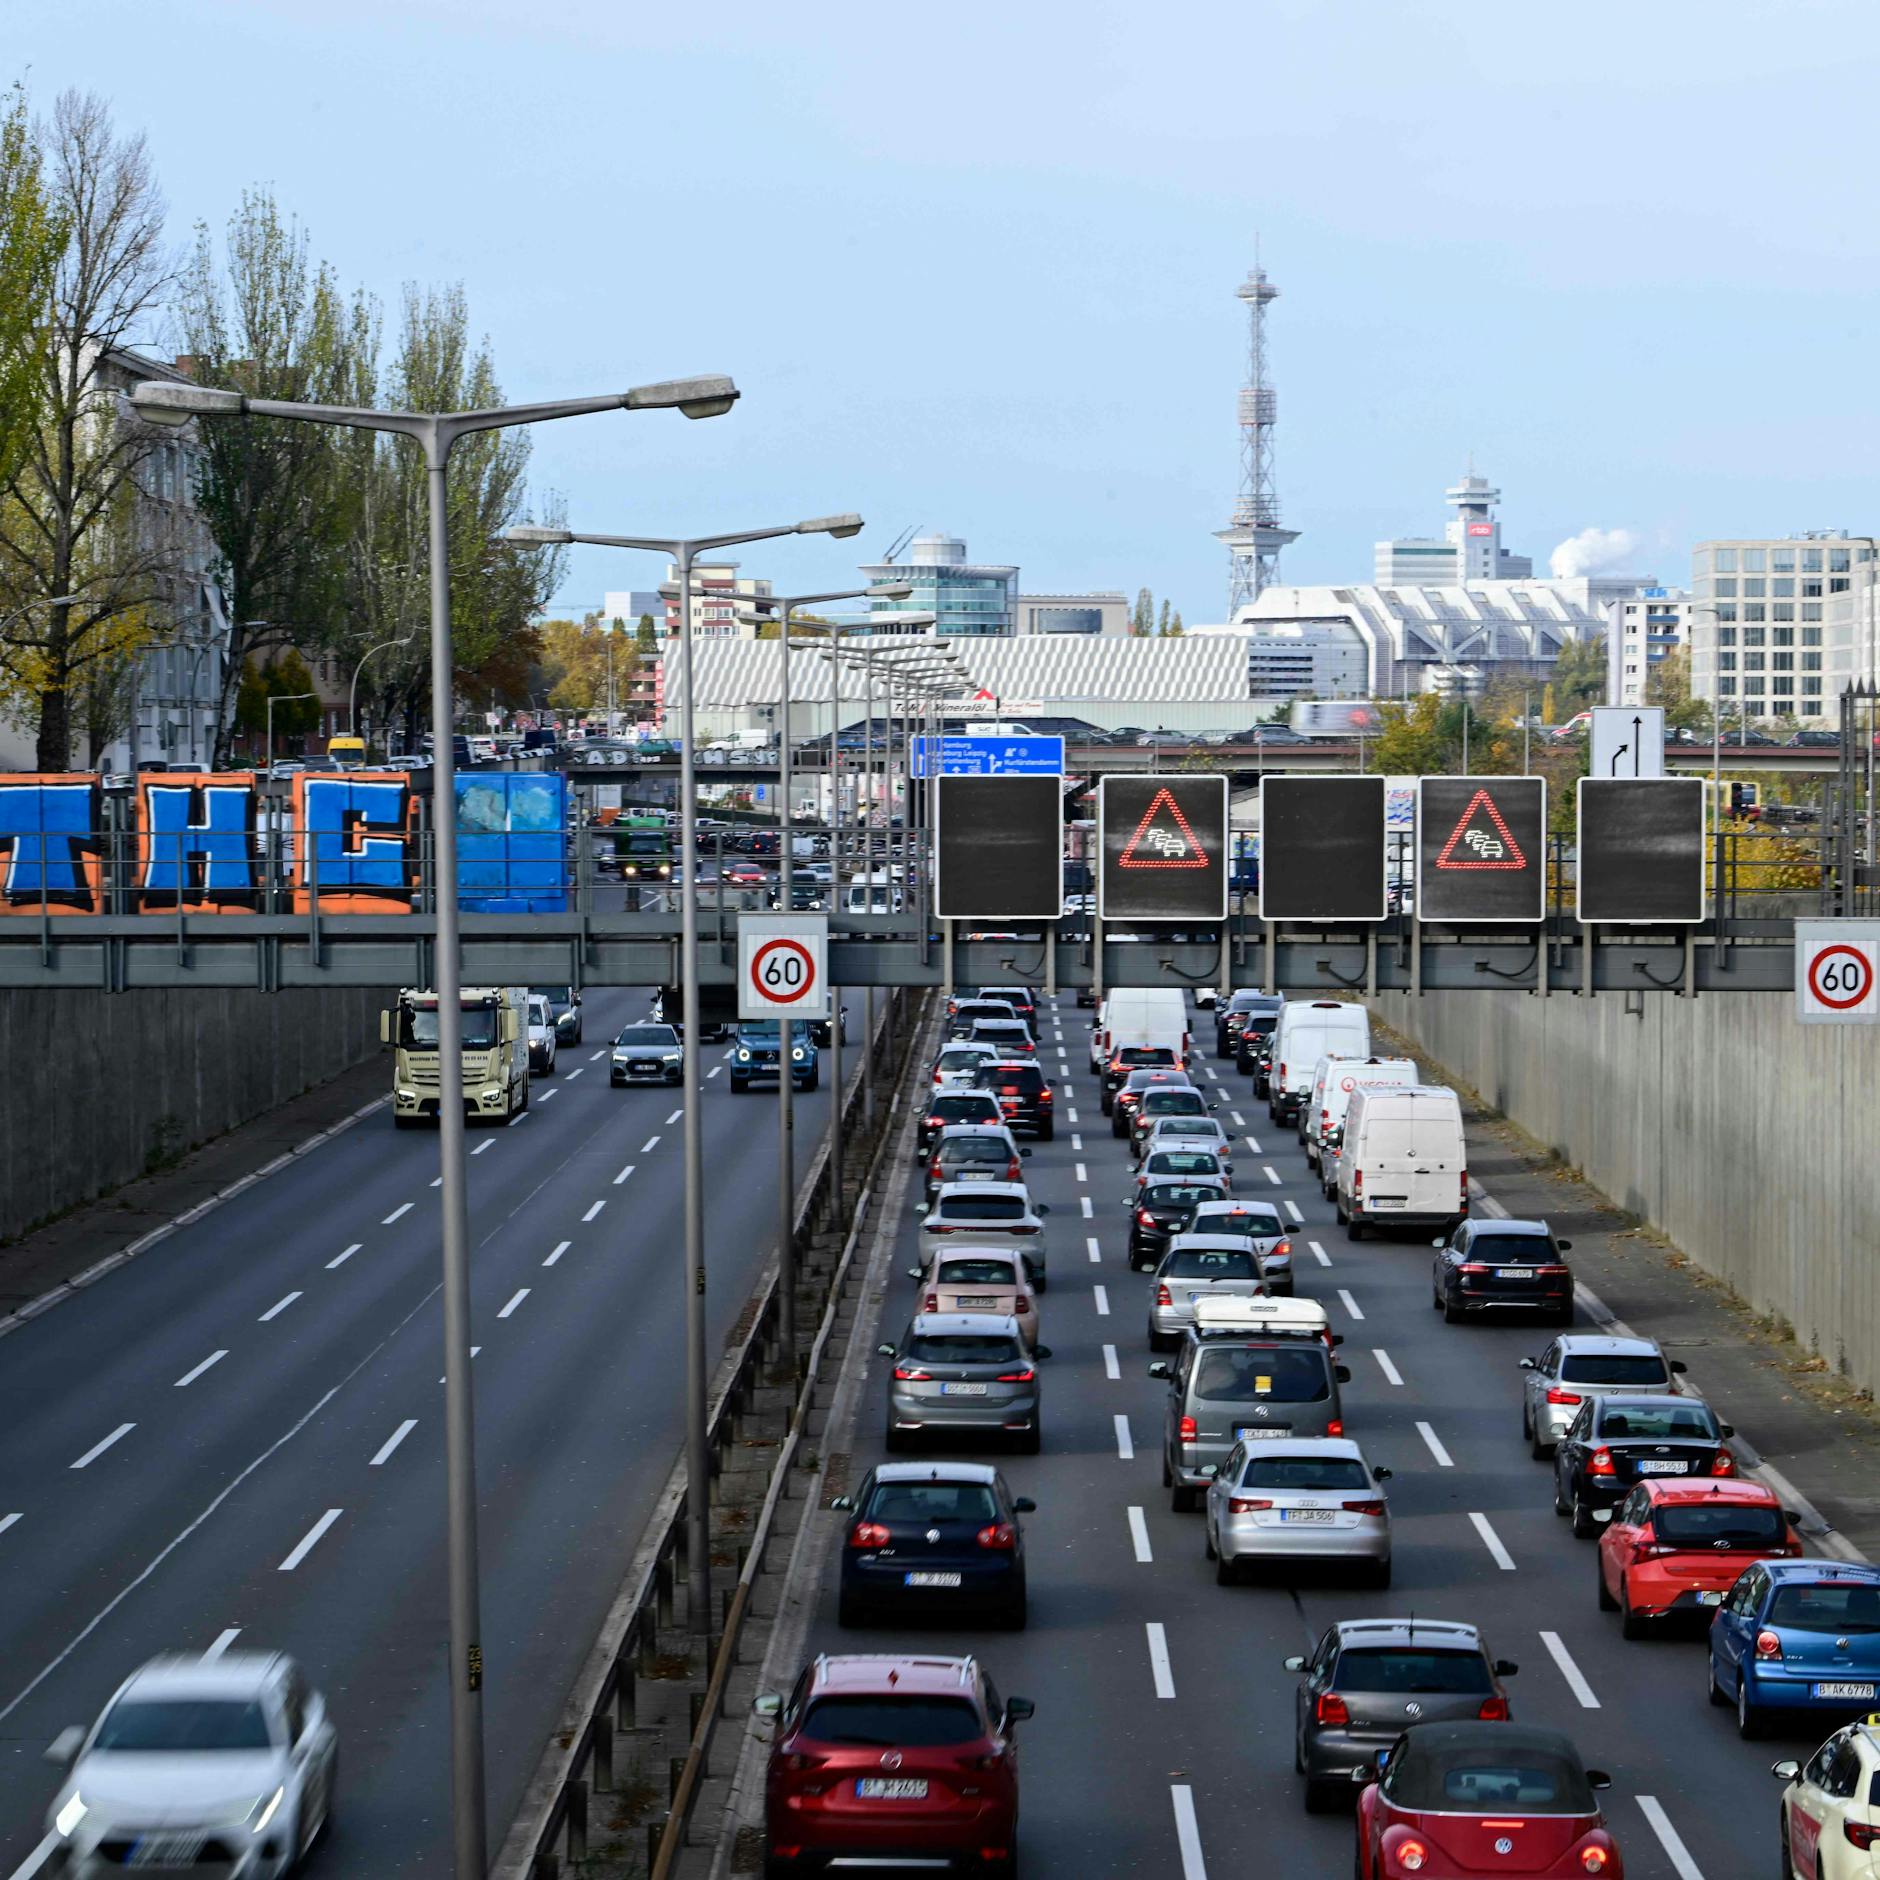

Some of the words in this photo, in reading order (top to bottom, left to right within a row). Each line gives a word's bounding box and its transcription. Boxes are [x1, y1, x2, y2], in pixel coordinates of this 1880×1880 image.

[765, 957, 801, 986] 60
[1822, 963, 1859, 992] 60
[1833, 1684, 1845, 1695] AK
[1847, 1684, 1872, 1696] 6778
